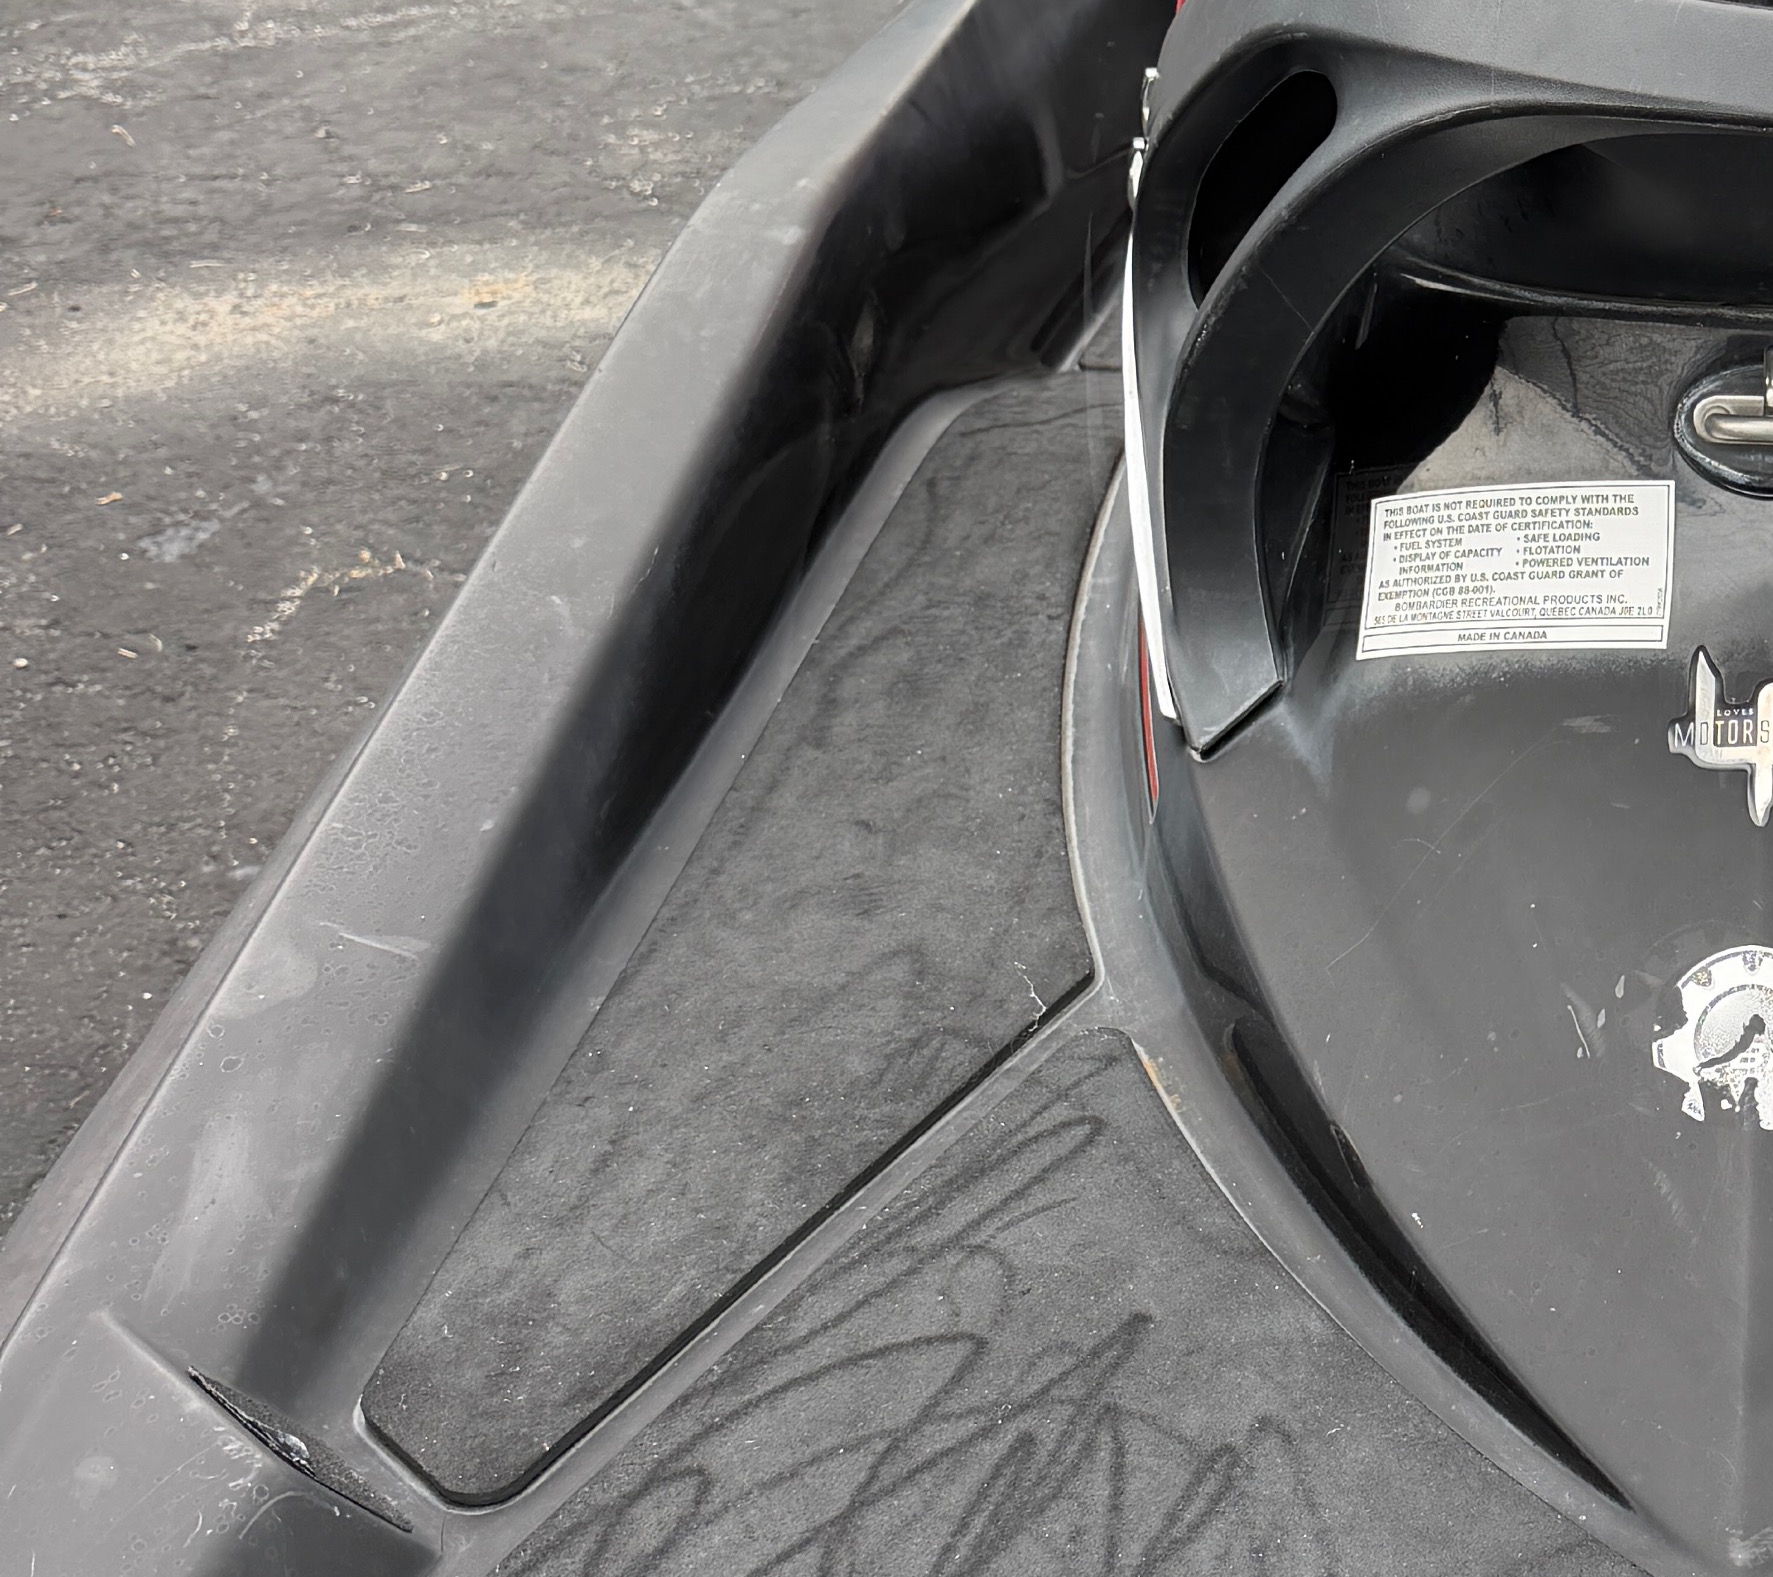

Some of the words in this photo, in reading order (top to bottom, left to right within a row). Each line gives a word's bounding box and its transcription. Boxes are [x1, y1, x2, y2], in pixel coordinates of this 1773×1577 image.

[1465, 497, 1515, 508] REQUIRED
[1535, 495, 1577, 504] COMPLY
[1580, 494, 1608, 503] WITH
[1383, 515, 1434, 529] FOLLOWING
[1457, 511, 1490, 521] COAST
[1492, 509, 1528, 518] GUARD
[1530, 507, 1570, 517] SAFETY
[1573, 507, 1639, 515] STANDARDS
[1394, 528, 1427, 540] EFFECT
[1510, 520, 1593, 530] CERTIFICATION:
[1424, 538, 1462, 548] SYSTEM
[1523, 534, 1549, 542] SAFE
[1552, 532, 1600, 541] LOADING
[1398, 552, 1436, 562] DISPLAY
[1454, 548, 1502, 558] CAPACITY
[1523, 545, 1580, 555] FLOTATION
[1398, 562, 1463, 574] INFORMATION
[1522, 558, 1573, 568] POWERED
[1576, 557, 1649, 566] VENTILATION
[1392, 575, 1451, 588] AUTHORIZED
[1491, 571, 1525, 581] COAST
[1528, 570, 1565, 579] GUARD
[1568, 569, 1605, 578] GRANT
[1377, 588, 1429, 600] EXEMPTION
[1394, 599, 1458, 611] BOMBARDIER
[1460, 596, 1540, 607] RECREATIONAL
[1542, 594, 1603, 604] PRODUCTS
[1457, 632, 1486, 641] MADE
[1503, 631, 1547, 639] CANADA
[1716, 708, 1754, 717] LOVES
